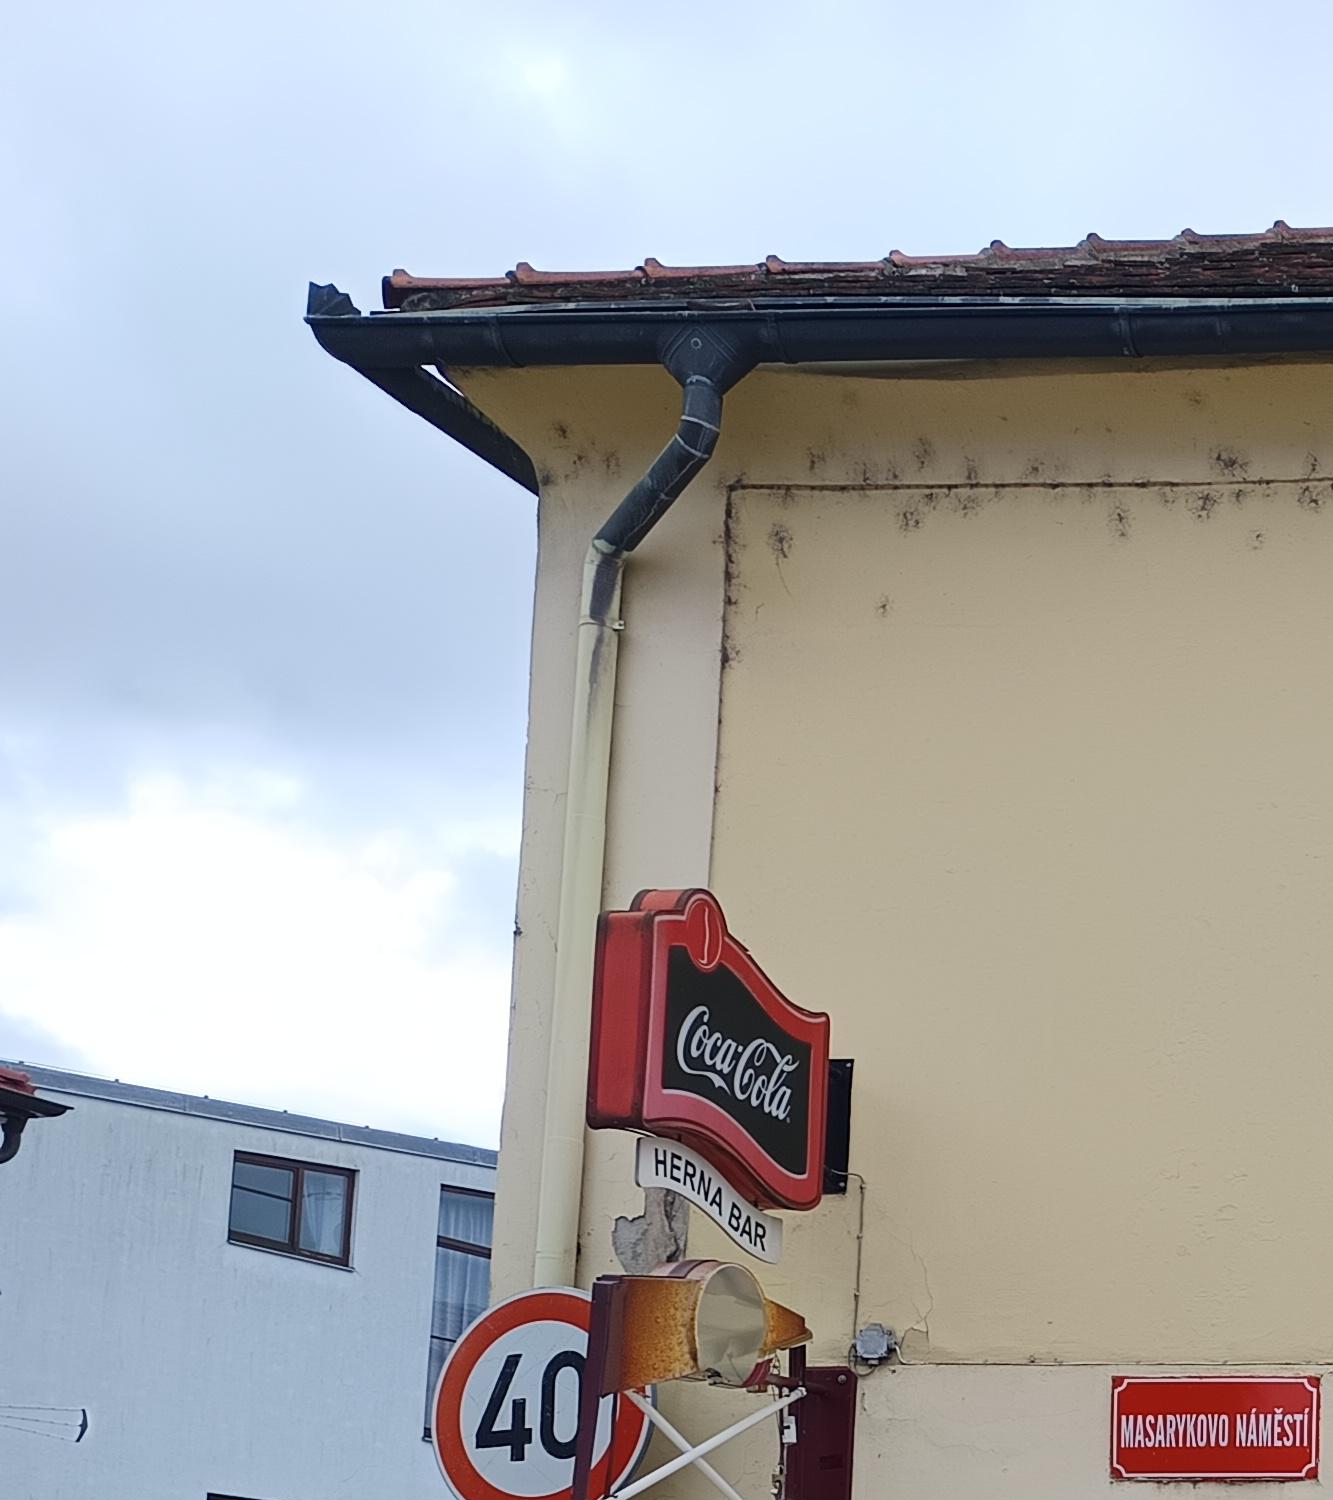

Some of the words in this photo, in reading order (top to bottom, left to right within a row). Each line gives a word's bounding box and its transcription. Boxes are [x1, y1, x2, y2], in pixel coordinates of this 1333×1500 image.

[676, 1005, 800, 1123] Coca-Cola
[654, 1147, 723, 1217] HERNA
[727, 1201, 768, 1252] BAR
[475, 1350, 585, 1462] 40
[1120, 1413, 1229, 1448] MASARYKOVO
[1235, 1407, 1309, 1448] NÁMĚSTÍ
